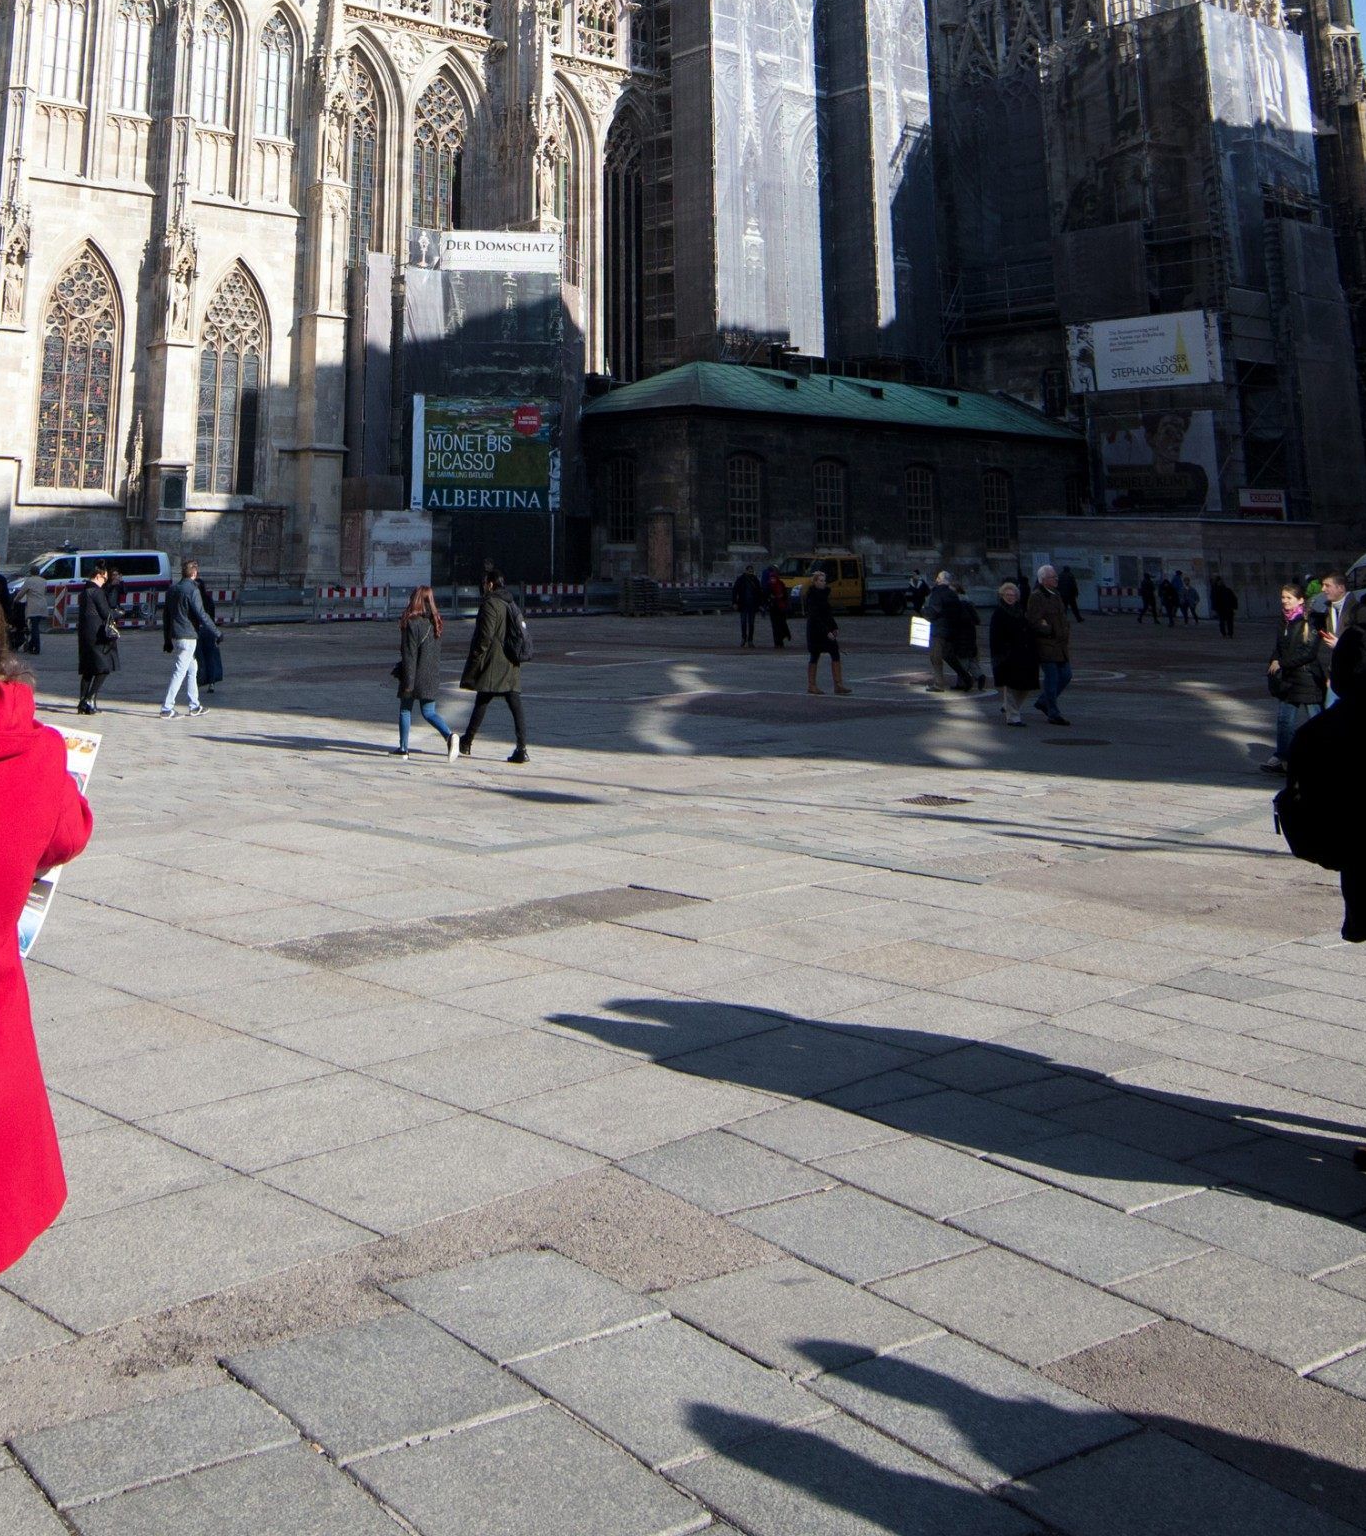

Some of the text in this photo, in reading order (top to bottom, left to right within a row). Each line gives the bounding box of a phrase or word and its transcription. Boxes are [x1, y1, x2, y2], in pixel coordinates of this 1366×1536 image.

[446, 239, 556, 253] DER DOMSCHATZ
[1159, 354, 1187, 364] UNSER
[1111, 363, 1189, 379] STEPHANSDOM
[428, 433, 512, 453] MONET BIS
[427, 452, 495, 471] PICASSO
[428, 488, 542, 509] ALBERTINA
